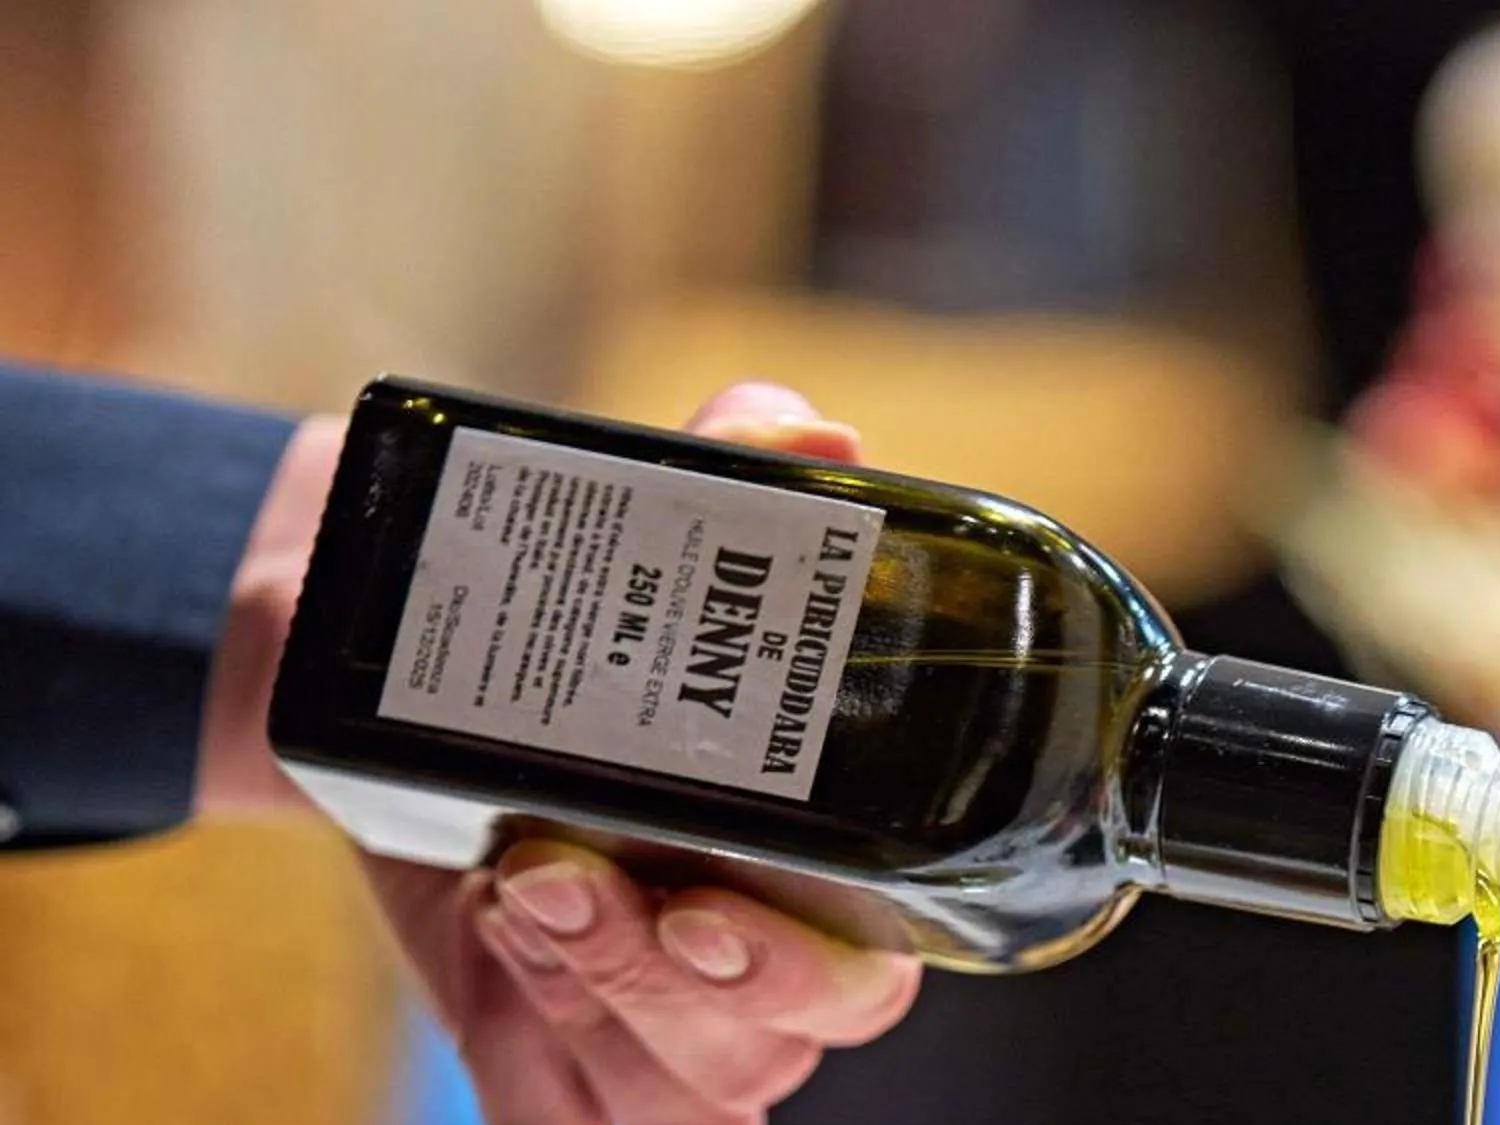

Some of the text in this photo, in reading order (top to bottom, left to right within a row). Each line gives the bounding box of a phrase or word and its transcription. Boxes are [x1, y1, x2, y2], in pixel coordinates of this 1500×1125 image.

[624, 564, 662, 607] 250
[613, 611, 650, 643] ML
[677, 546, 773, 718] DENNY
[757, 631, 788, 661] DE
[760, 526, 859, 775] LA PIRICUDDARA
[637, 678, 664, 727] EXTRA
